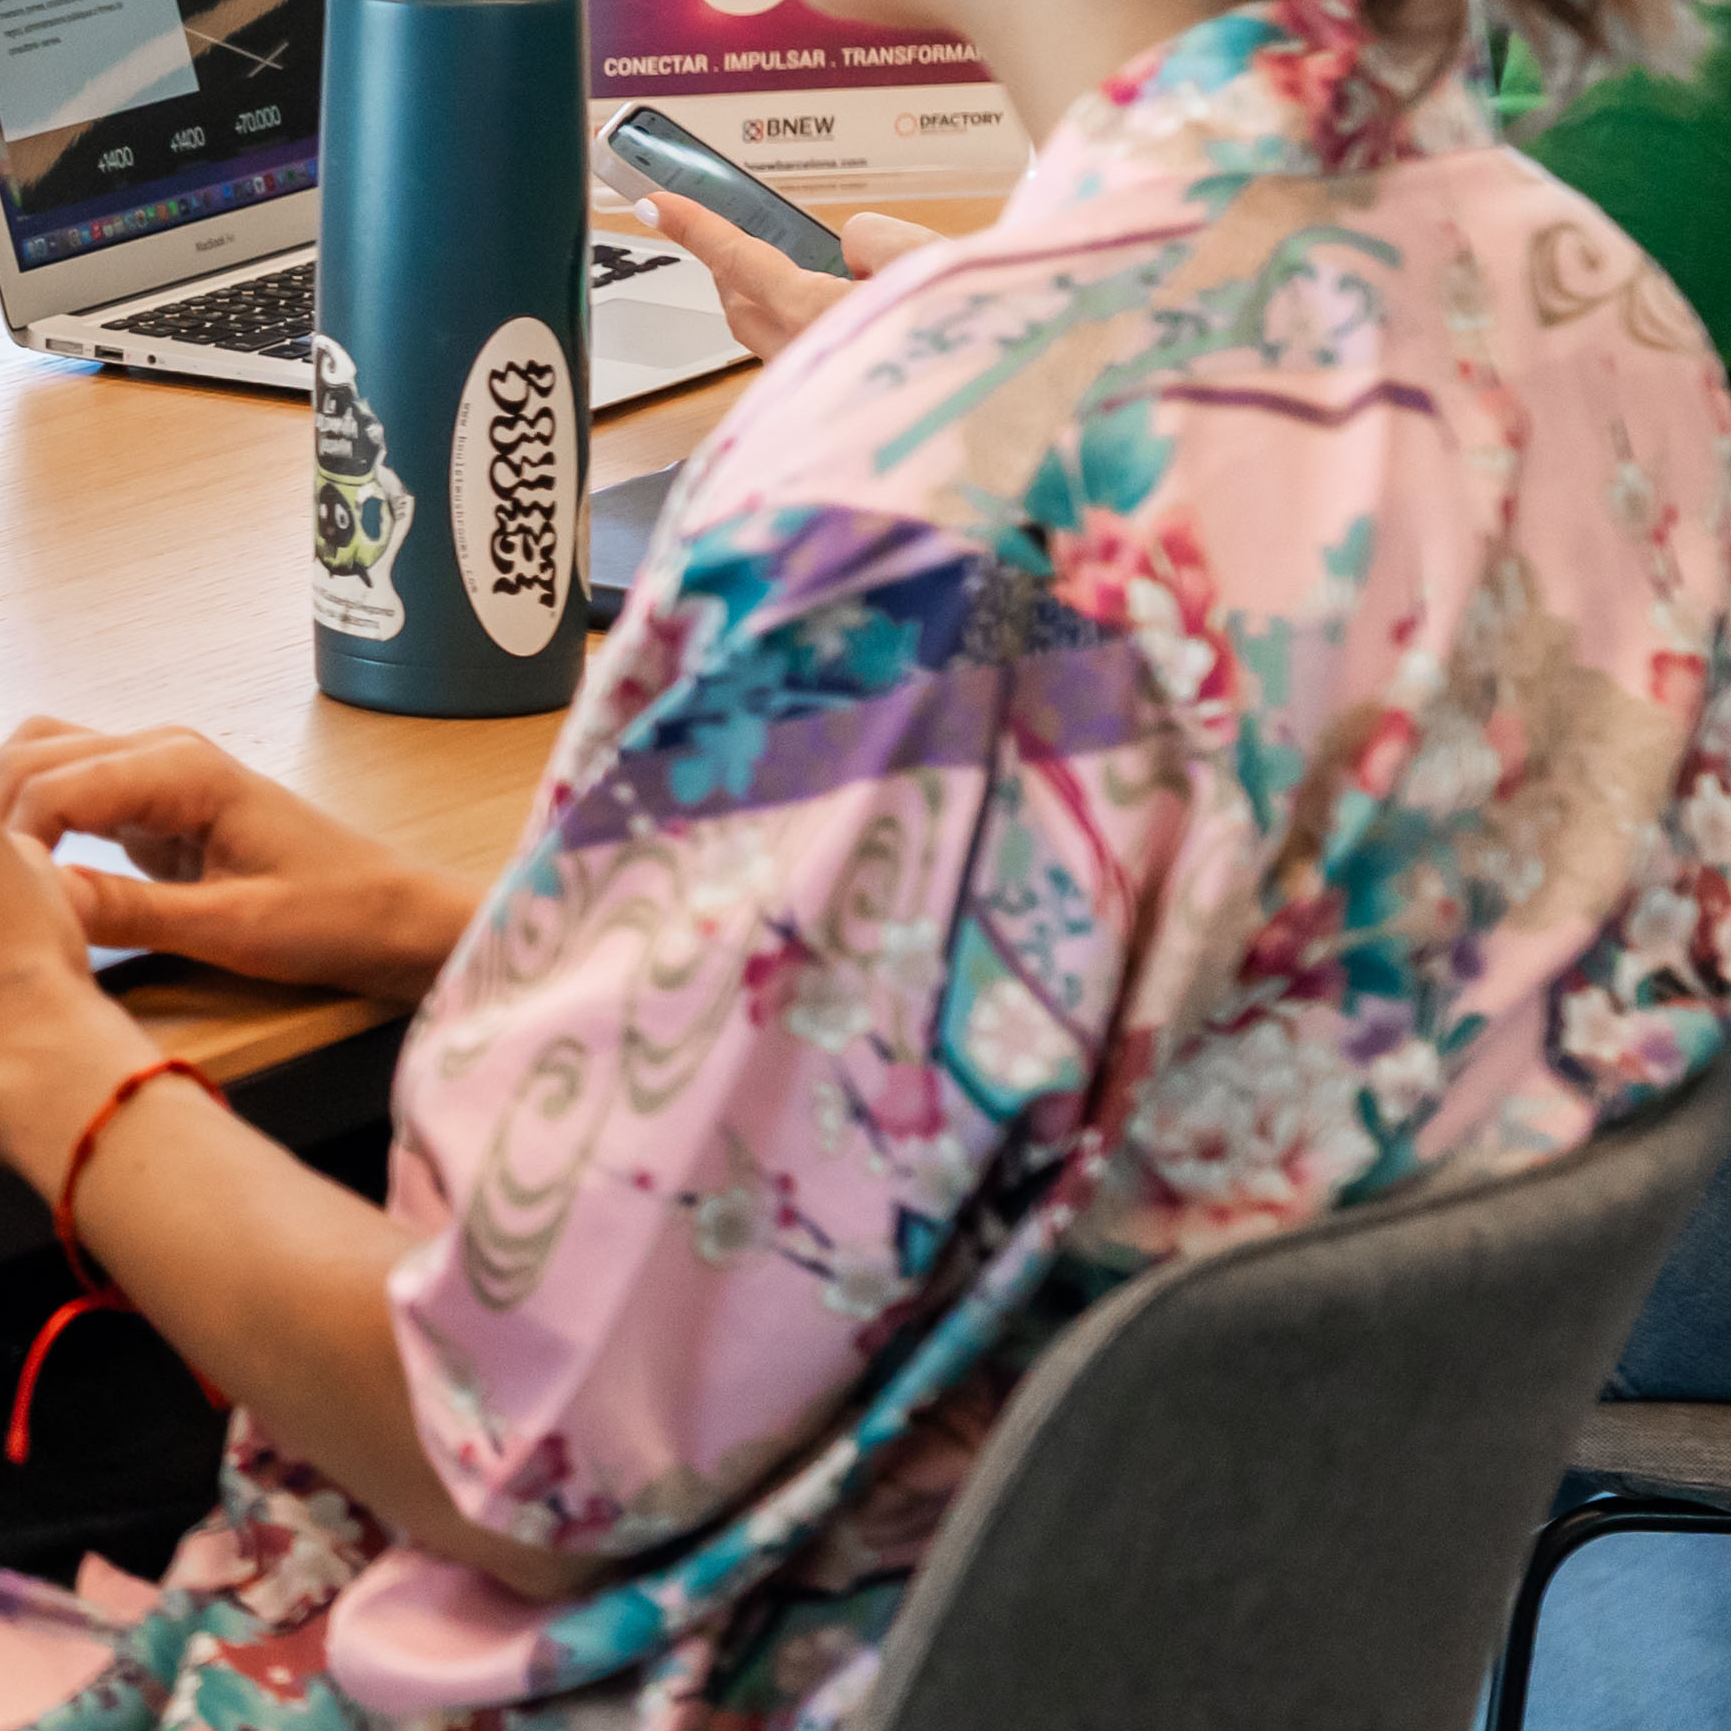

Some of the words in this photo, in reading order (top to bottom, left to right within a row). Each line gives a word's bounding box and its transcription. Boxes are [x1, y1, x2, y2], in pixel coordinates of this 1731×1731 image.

[603, 53, 709, 78] CONECTAR
[724, 48, 827, 72] IMPULSAR
[841, 42, 978, 67] TRANSFORMA
[766, 115, 836, 137] BNEW
[919, 110, 1005, 130] DFACTORY
